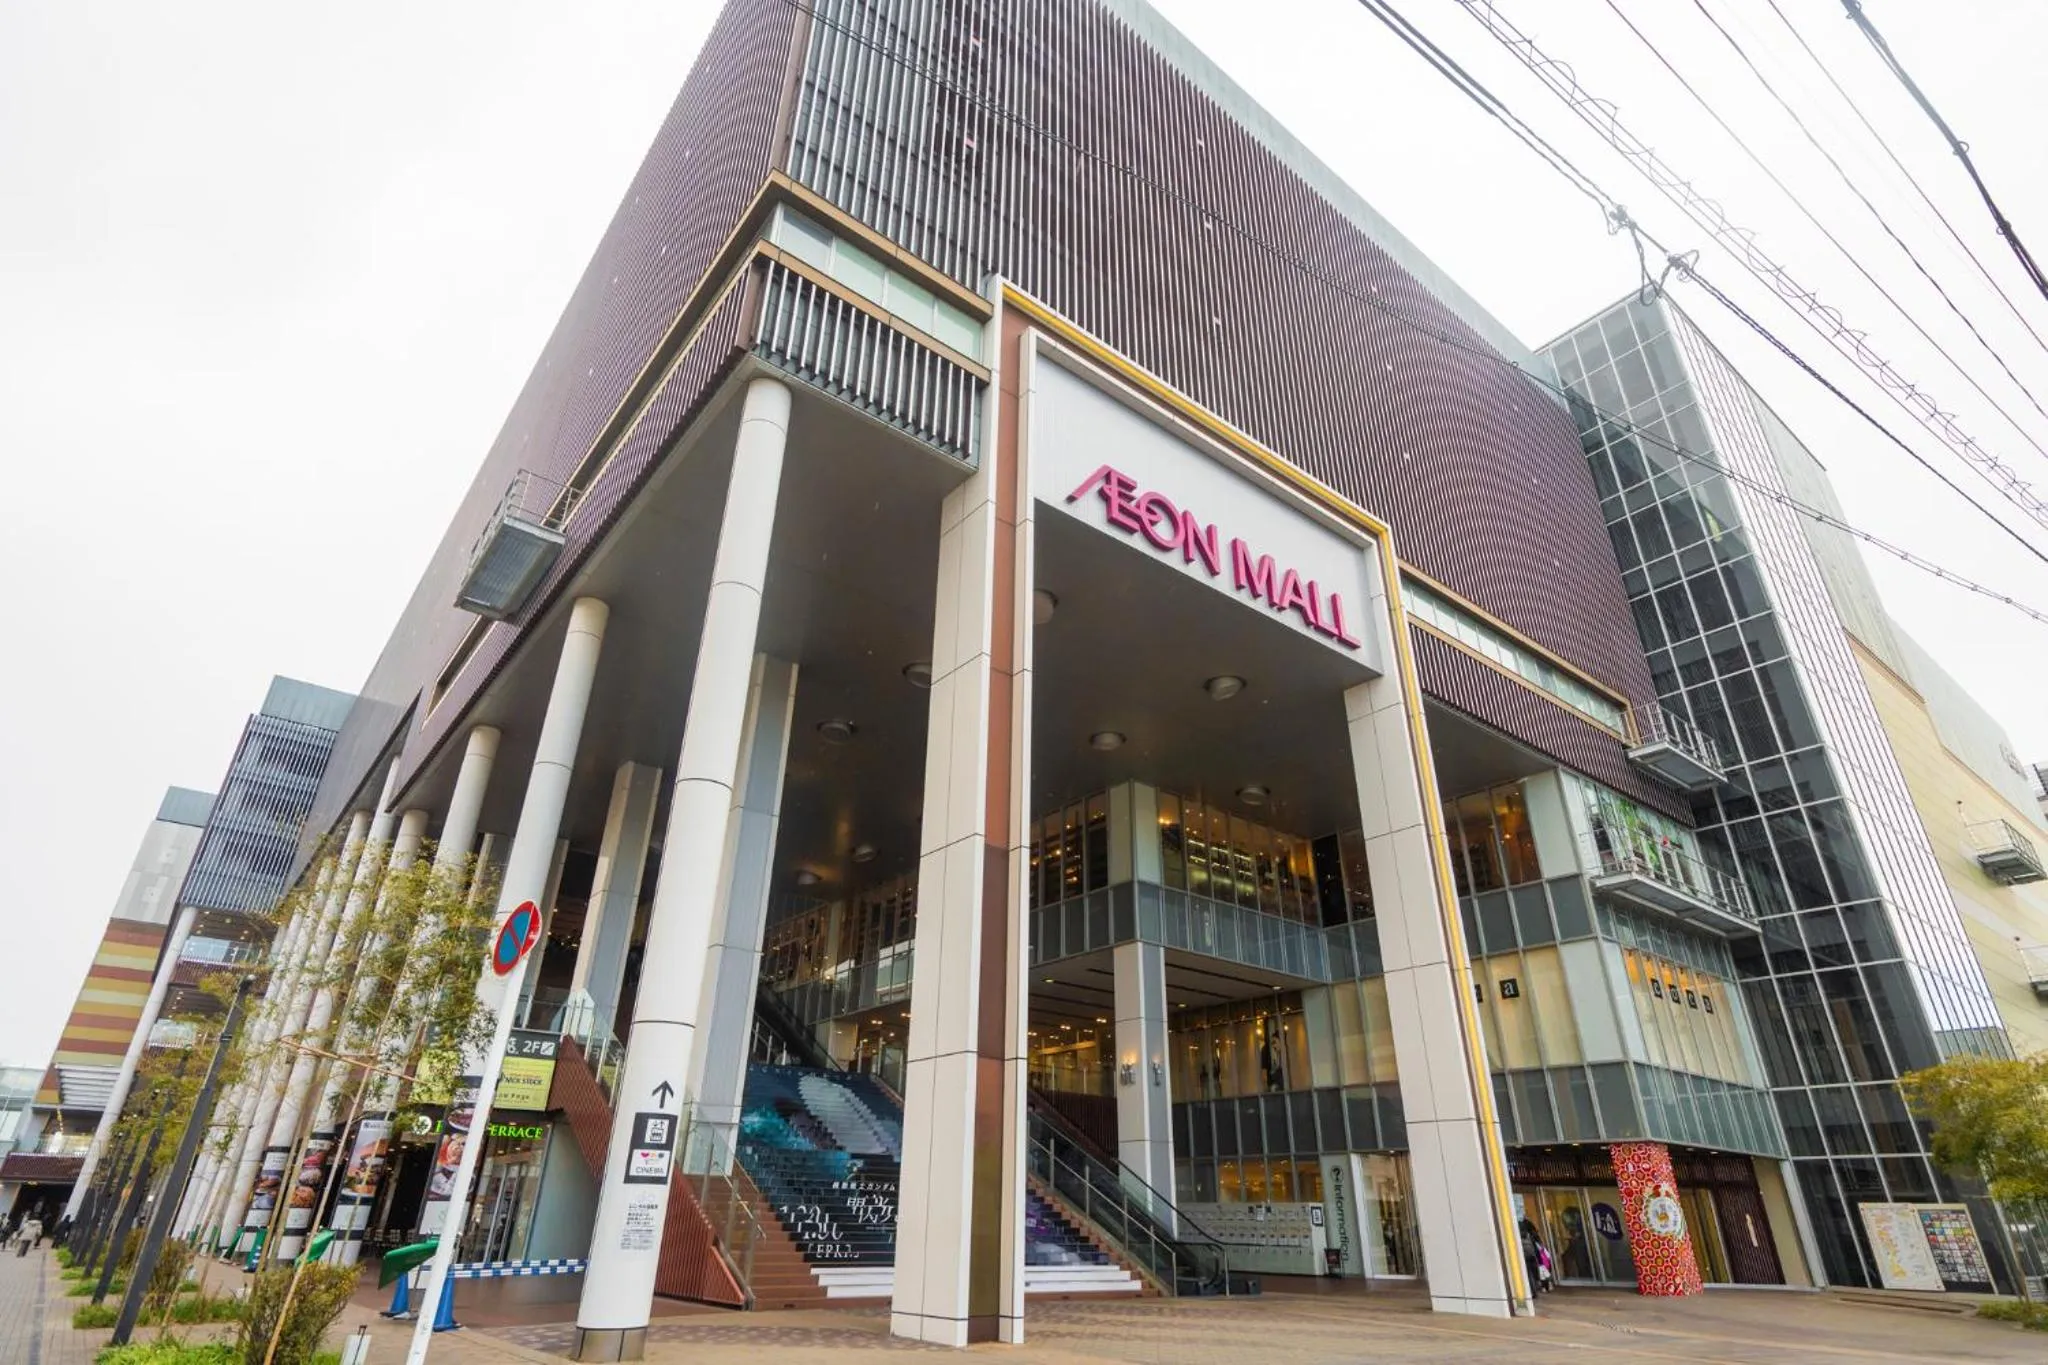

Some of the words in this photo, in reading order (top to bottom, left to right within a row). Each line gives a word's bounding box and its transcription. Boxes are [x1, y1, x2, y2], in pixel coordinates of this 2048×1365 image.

[1231, 537, 1361, 649] MALL
[522, 1040, 541, 1053] 2F
[846, 1193, 899, 1224] 閃光
